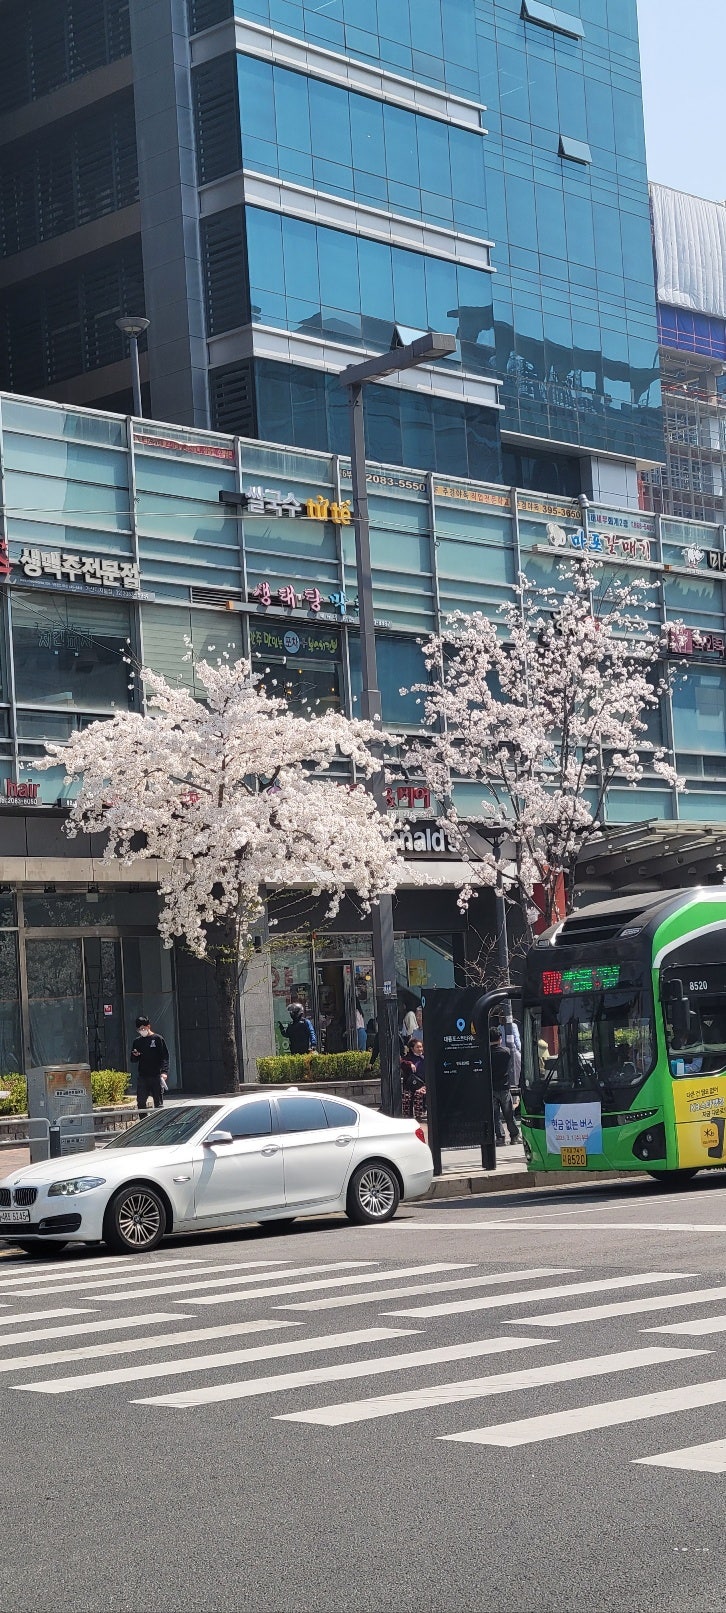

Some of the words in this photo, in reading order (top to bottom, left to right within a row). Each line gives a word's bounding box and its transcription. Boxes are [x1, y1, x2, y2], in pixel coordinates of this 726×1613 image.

[365, 473, 426, 493] 2083-5550
[245, 486, 301, 518] 쌀국수
[543, 505, 581, 519] 395-3650
[20, 548, 141, 591] 생맥주전문점
[286, 636, 298, 648] 포차
[6, 778, 40, 798] hair
[689, 980, 708, 991] 8520
[551, 1119, 564, 1131] 현금
[565, 1119, 578, 1131] 없는
[580, 1118, 594, 1129] 버스
[567, 1154, 585, 1165] 8520
